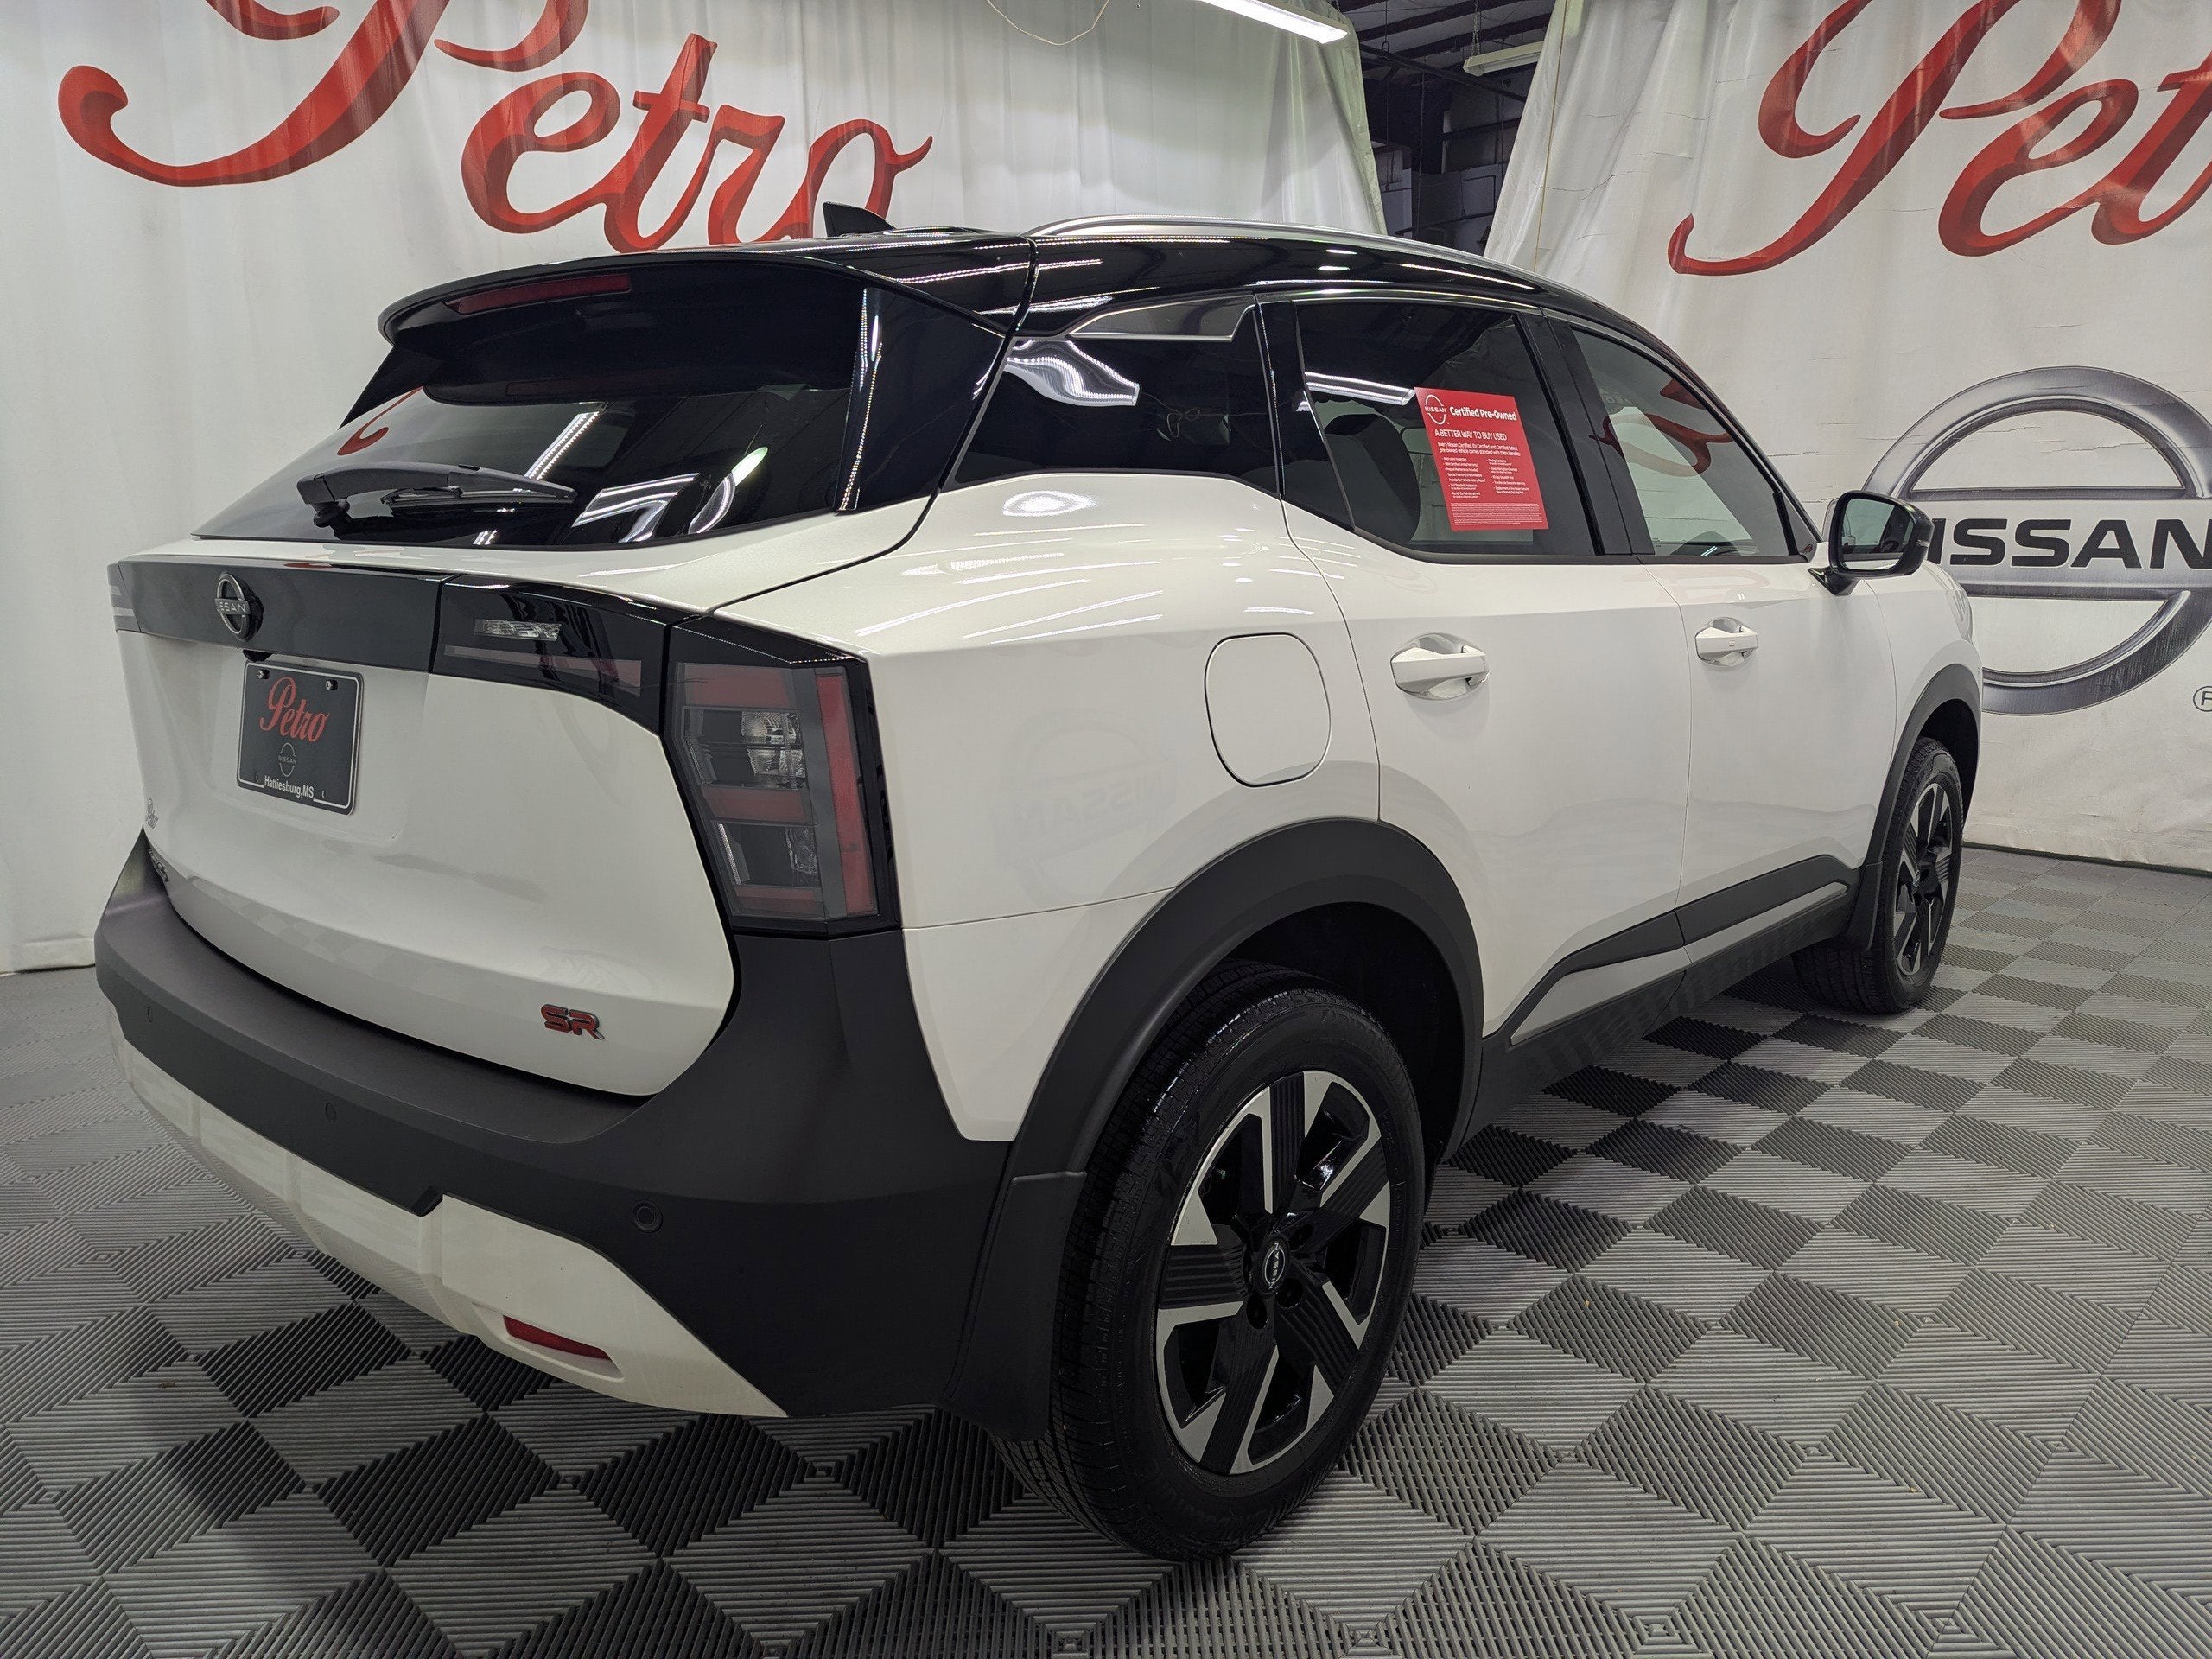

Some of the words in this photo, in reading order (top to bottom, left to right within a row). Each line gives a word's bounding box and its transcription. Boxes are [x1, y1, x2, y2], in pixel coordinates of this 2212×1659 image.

[1424, 405, 1447, 414] NISSAN
[1450, 406, 1480, 418] Certified
[1479, 409, 1517, 421] Pre-Owned
[1434, 429, 1440, 437] A
[1440, 429, 1462, 438] BETTER
[1462, 430, 1473, 439] WAY
[1493, 432, 1507, 441] USED
[1926, 518, 2212, 569] ISSAN
[219, 601, 247, 613] SSAN
[258, 675, 331, 743] Petro
[277, 754, 298, 766] NISSAN
[540, 1003, 606, 1041] SR
